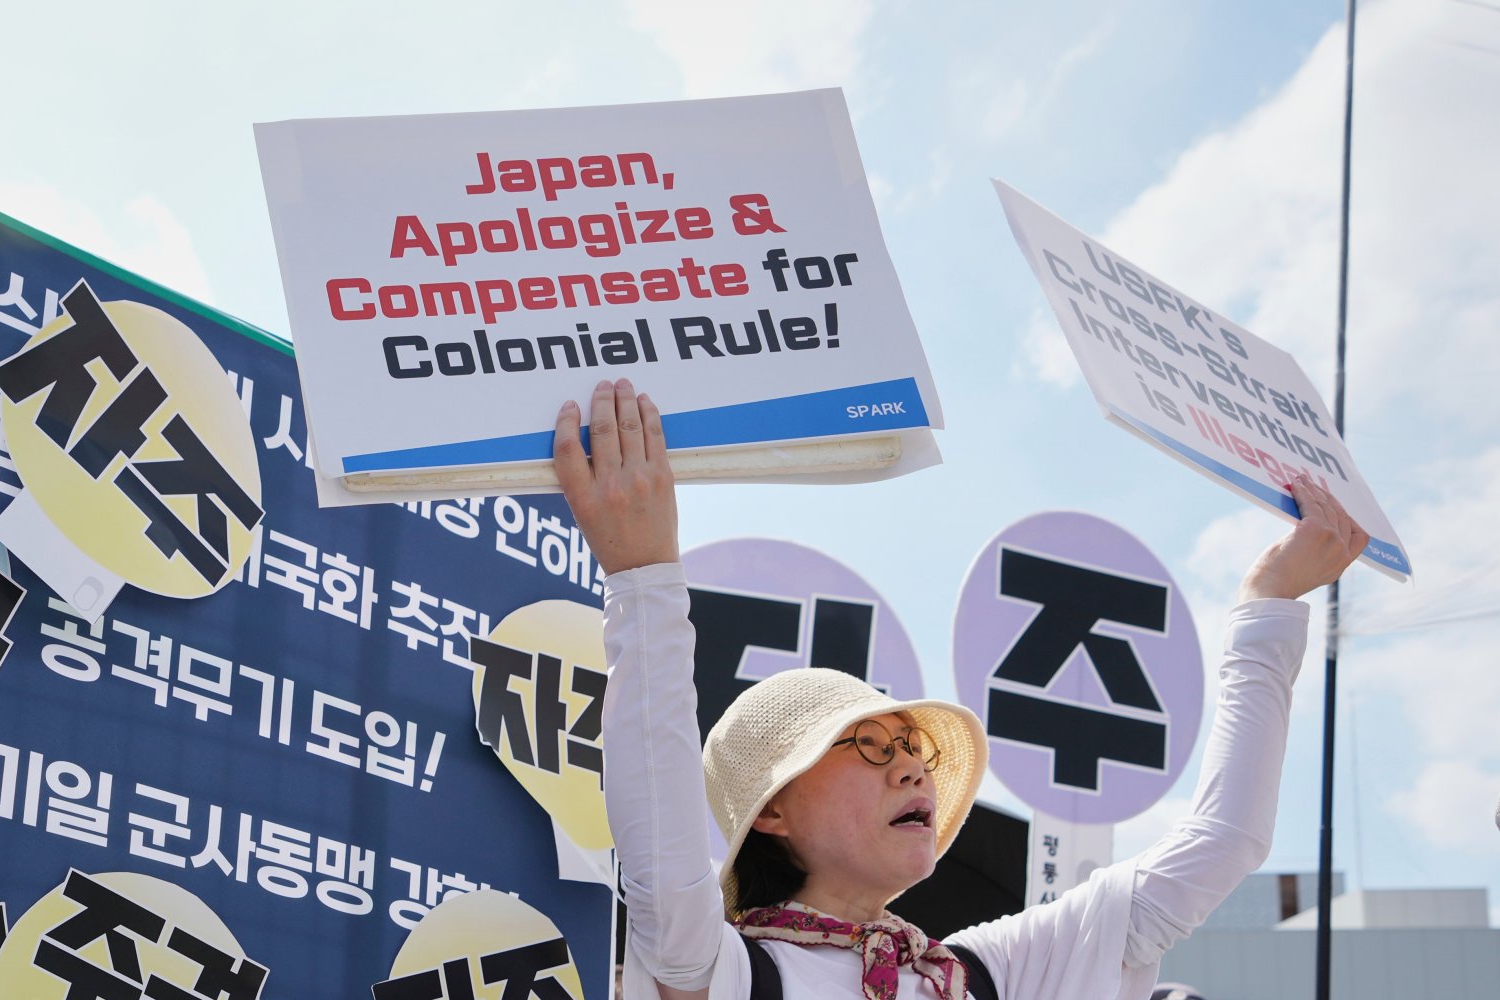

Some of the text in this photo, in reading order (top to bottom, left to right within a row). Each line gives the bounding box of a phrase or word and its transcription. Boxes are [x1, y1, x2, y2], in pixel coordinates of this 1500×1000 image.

[466, 152, 675, 202] Japan,
[390, 194, 787, 267] Apologize &
[326, 248, 858, 324] Compensate for
[1082, 240, 1248, 361] USFK's
[383, 302, 841, 380] Colonial Rule!
[1042, 248, 1328, 437] Cross-Strait
[1068, 297, 1349, 482] Intervention
[846, 401, 906, 419] SPARK
[1133, 371, 1186, 426] is
[41, 597, 447, 792] 공격무기 도입!
[988, 546, 1169, 792] 주
[128, 783, 375, 914] 군사동맹
